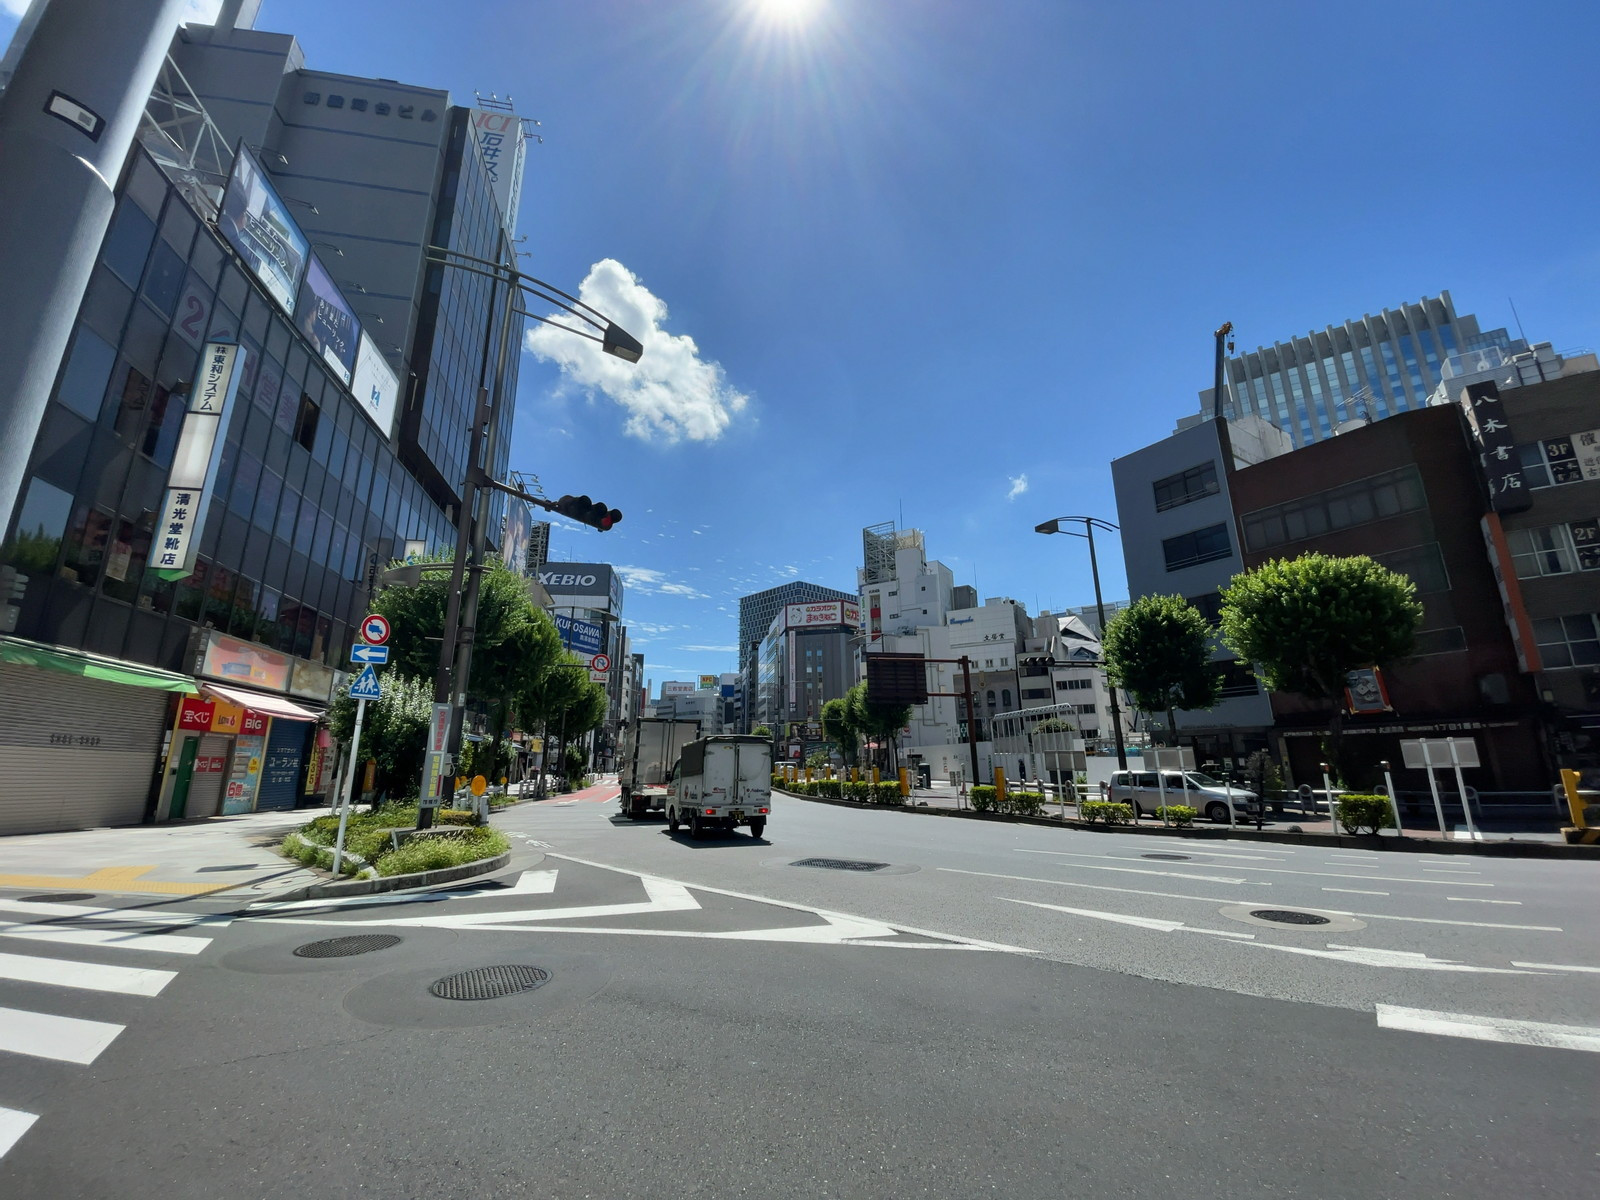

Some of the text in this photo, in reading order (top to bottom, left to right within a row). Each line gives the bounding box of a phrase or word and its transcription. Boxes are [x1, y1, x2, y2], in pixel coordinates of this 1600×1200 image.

[475, 112, 512, 132] ICI
[480, 131, 505, 183] 石井ス
[1474, 394, 1522, 493] 八木書店
[1547, 442, 1569, 457] 3F
[160, 492, 192, 566] 清光堂靴店
[1574, 527, 1596, 541] 2F
[538, 571, 597, 587] XEBIO
[183, 710, 210, 724] 宝くじ
[244, 718, 262, 729] BIG
